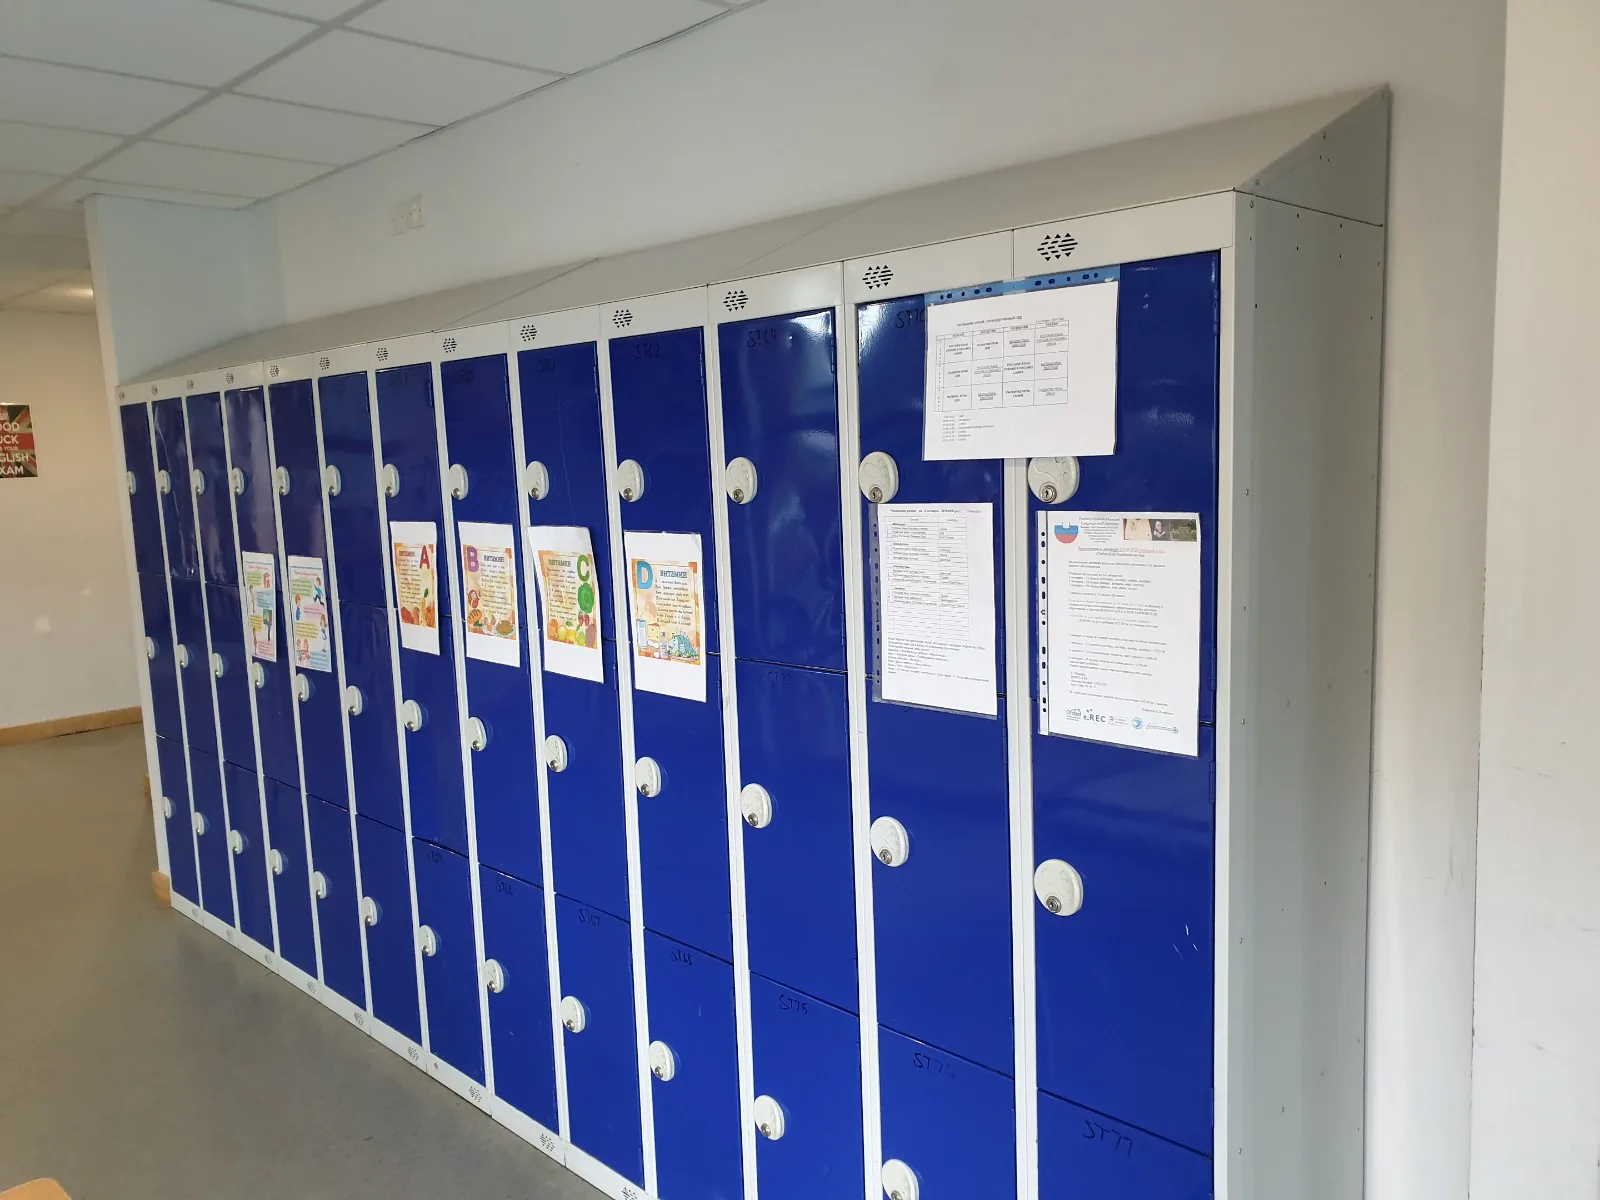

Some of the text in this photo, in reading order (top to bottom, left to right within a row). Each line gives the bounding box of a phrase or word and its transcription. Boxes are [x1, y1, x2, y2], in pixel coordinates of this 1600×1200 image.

[0, 422, 20, 431] OD
[0, 434, 19, 444] CK
[420, 545, 430, 569] A
[466, 547, 479, 572] B
[576, 554, 590, 582] C
[636, 561, 653, 589] D
[779, 994, 808, 1015] ST75
[1080, 1118, 1131, 1159] ST77
